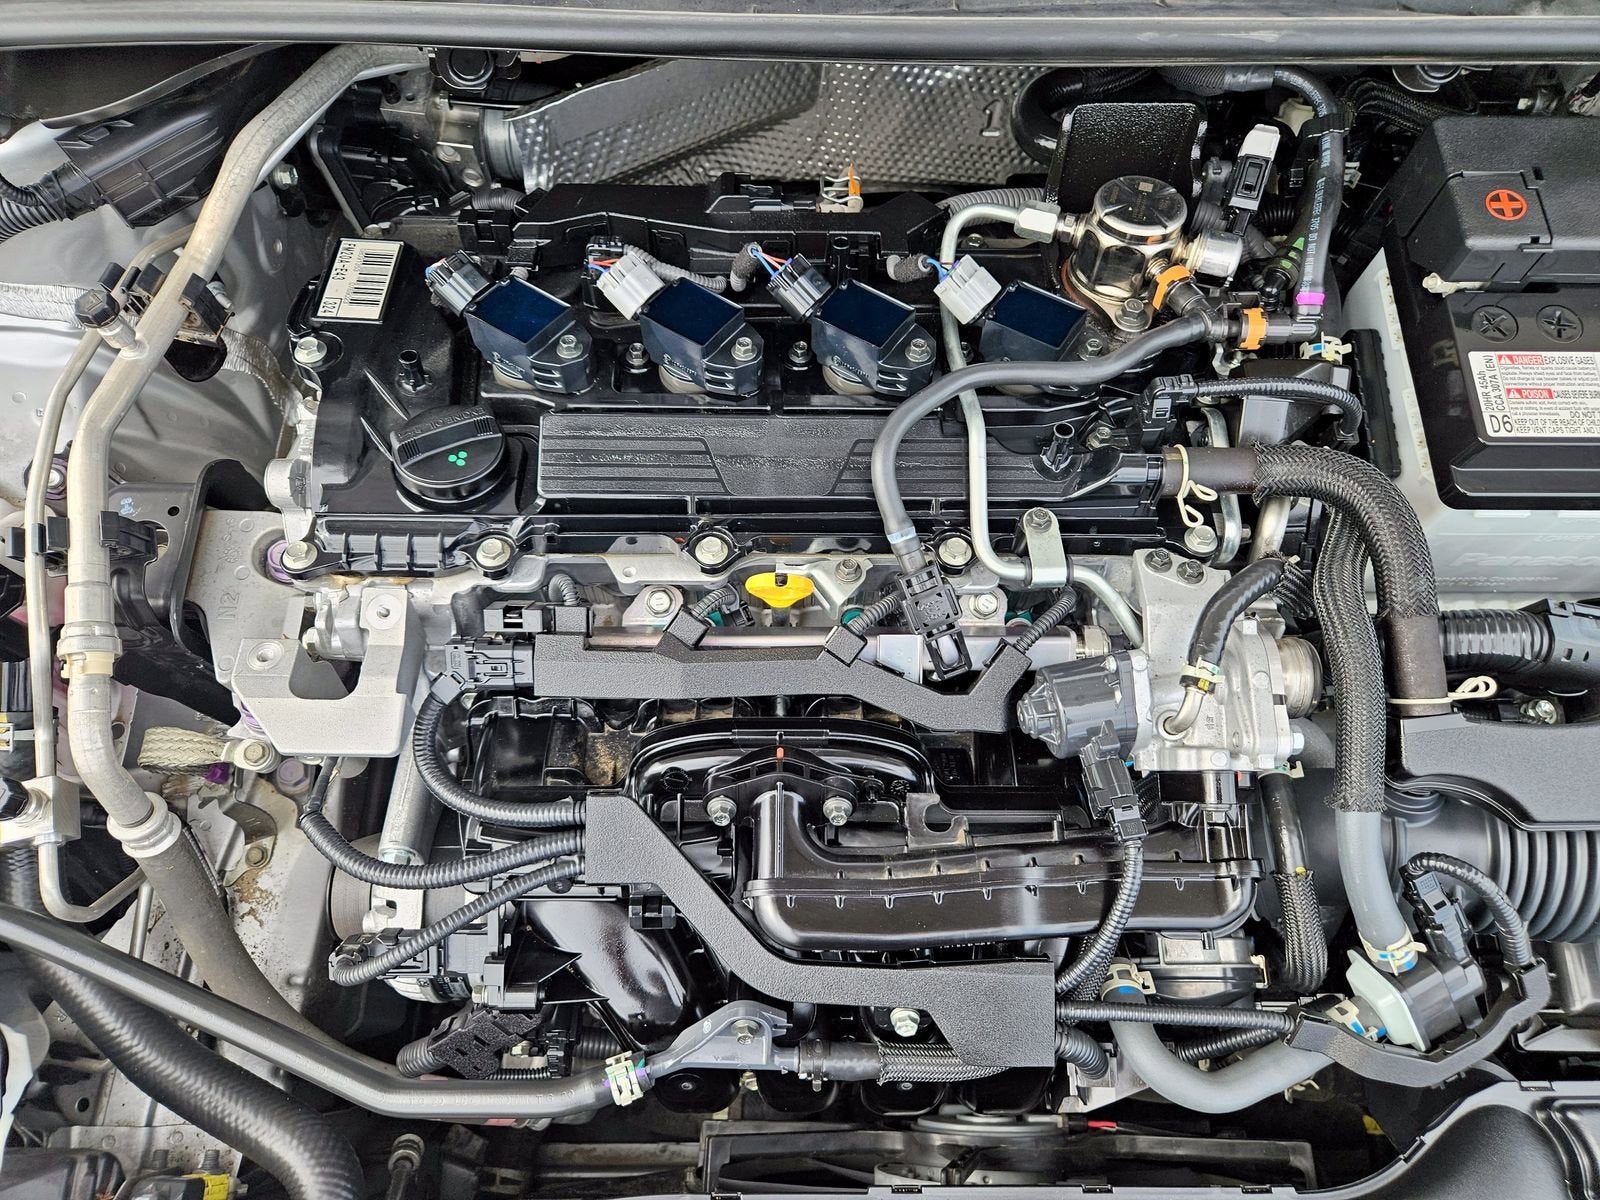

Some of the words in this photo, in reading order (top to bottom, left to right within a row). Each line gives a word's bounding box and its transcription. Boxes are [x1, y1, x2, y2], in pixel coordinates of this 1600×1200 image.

[1481, 354, 1497, 372] (EN)
[1513, 355, 1544, 365] DANGER
[1544, 355, 1573, 365] EXPLOSIVE
[1574, 355, 1595, 365] GASES
[1476, 370, 1489, 389] 45Ah
[1488, 374, 1502, 392] 307A
[1482, 391, 1495, 411] 20HR
[1493, 394, 1506, 411] CCA
[1521, 389, 1550, 399] POISON
[1489, 414, 1514, 433] D6
[1516, 426, 1531, 434] KEEP
